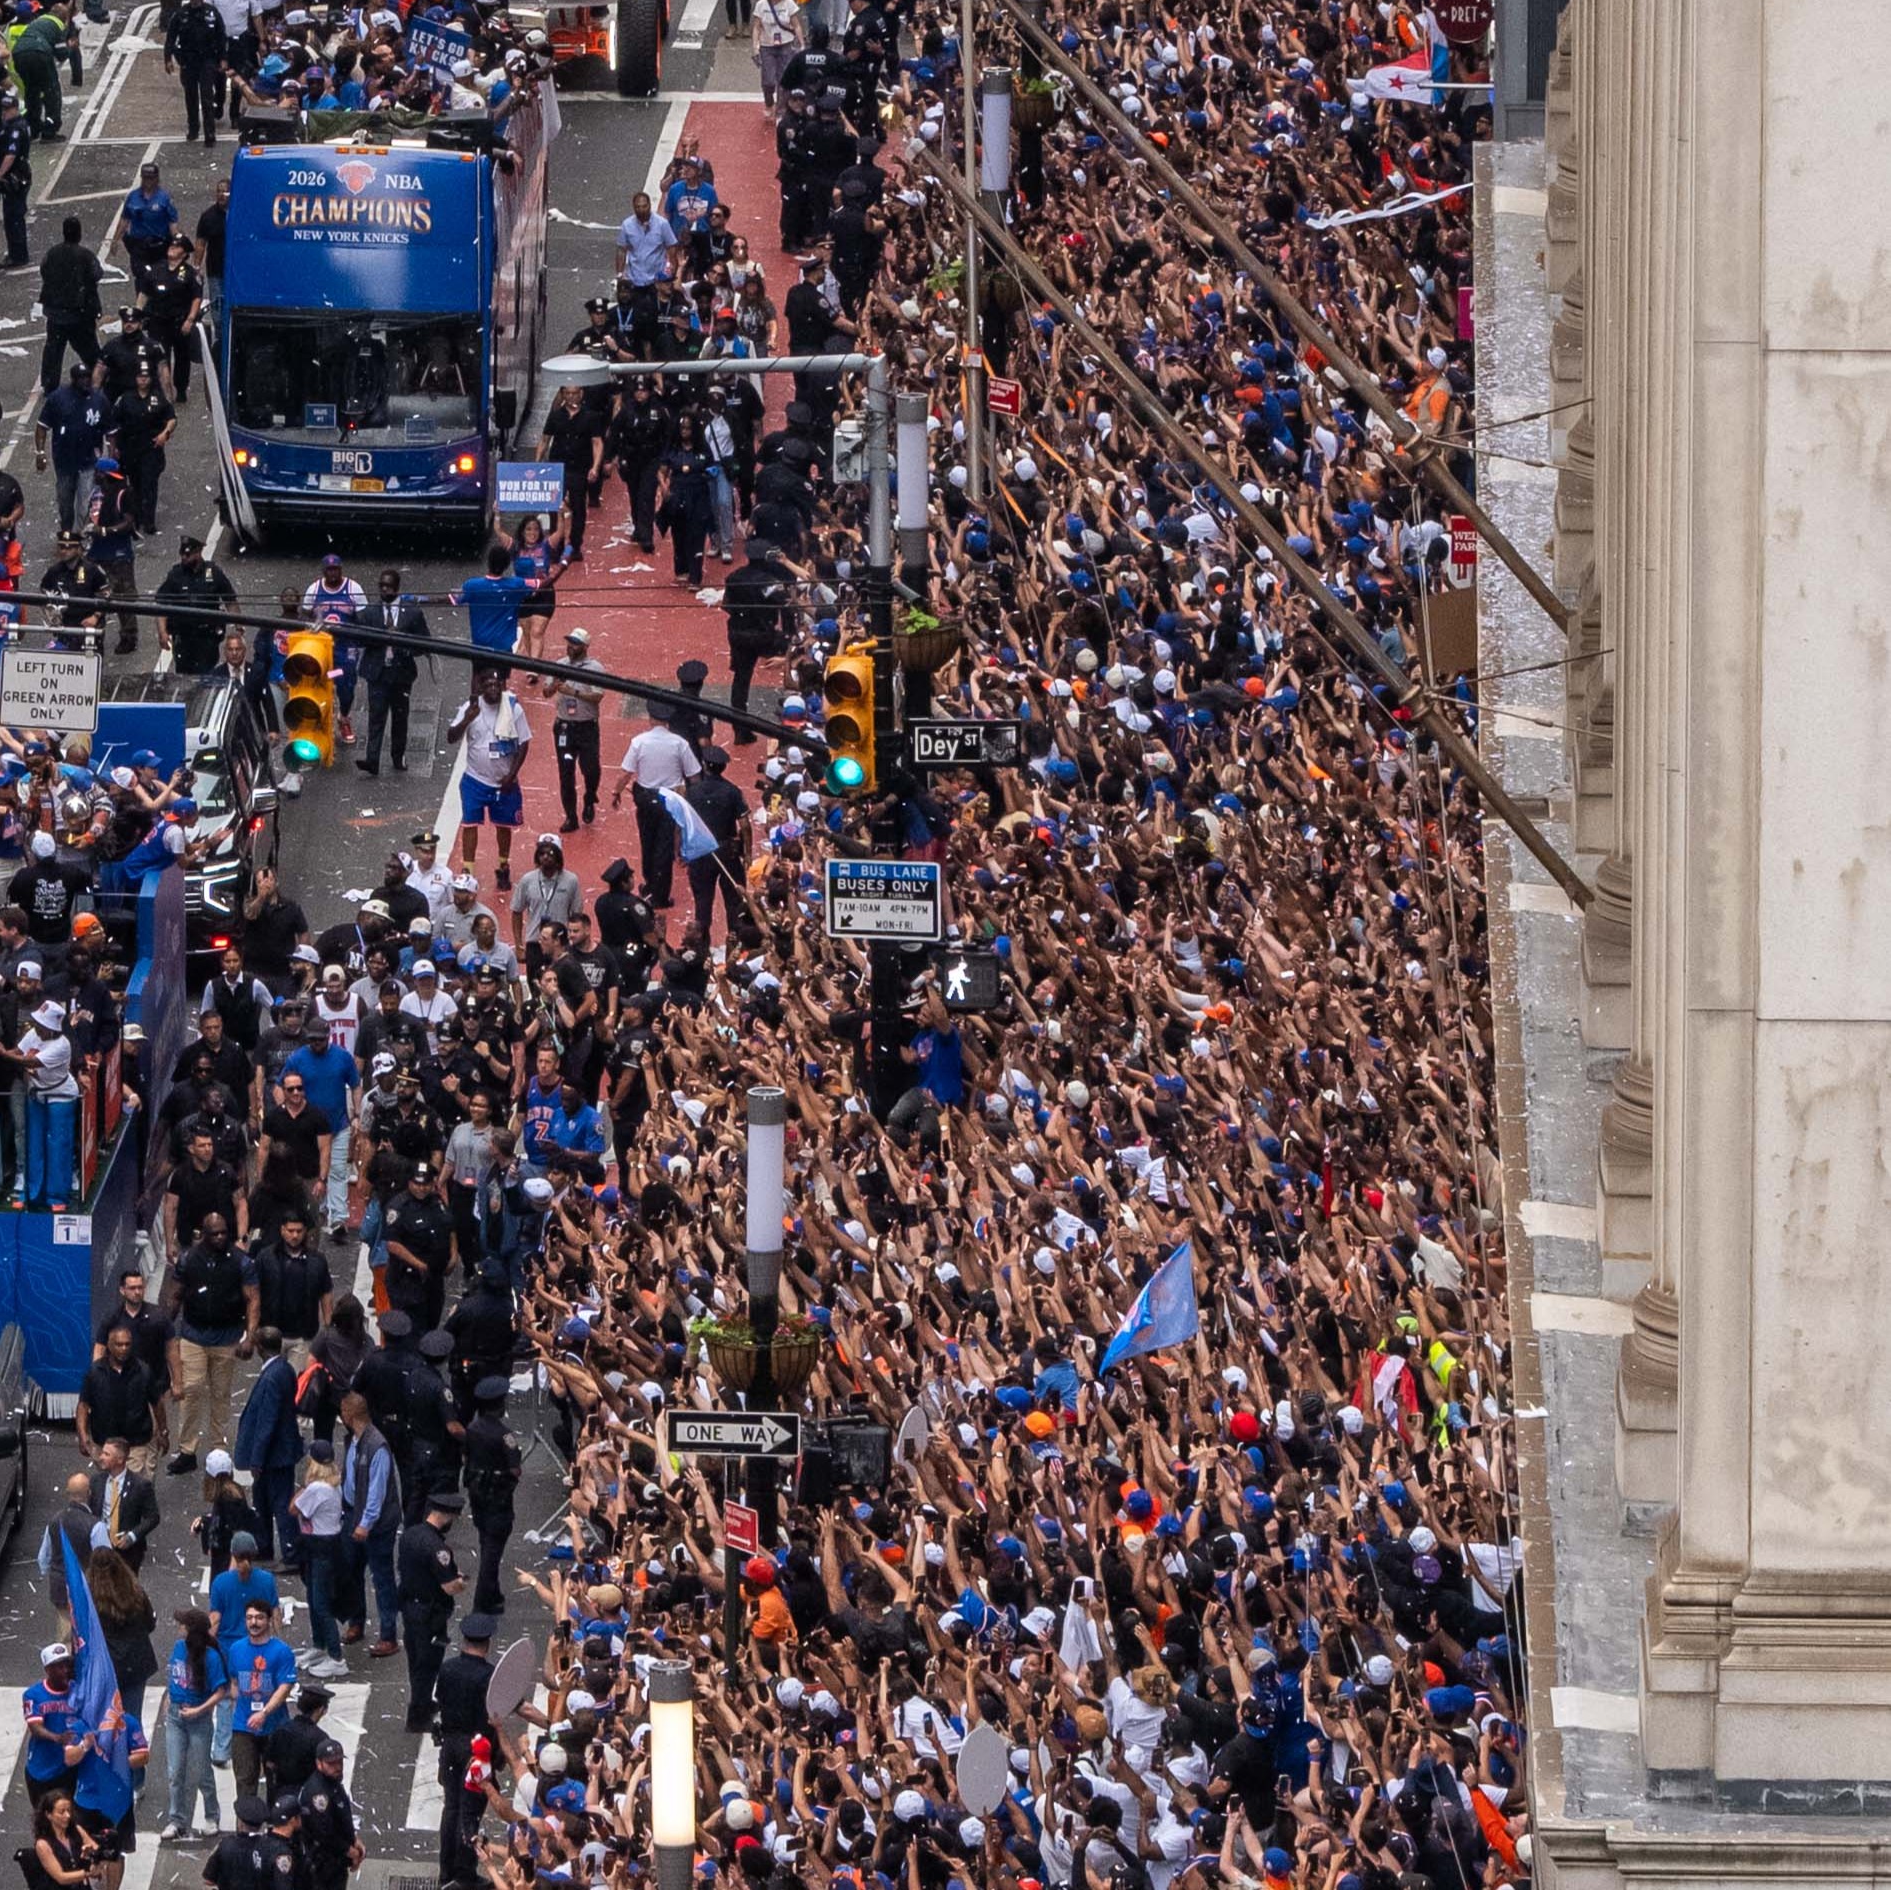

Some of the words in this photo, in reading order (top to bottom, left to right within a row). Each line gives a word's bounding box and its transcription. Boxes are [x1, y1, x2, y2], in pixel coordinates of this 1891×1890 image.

[1451, 5, 1479, 24] PRET
[412, 29, 448, 50] LET'S
[448, 42, 466, 58] GO
[409, 42, 462, 68] KNCKS
[288, 170, 326, 187] 2026
[385, 175, 424, 190] NBA
[272, 194, 432, 229] CHAMPIONS
[293, 229, 323, 242] NEW
[327, 230, 360, 243] YORK
[362, 231, 410, 245] KNICKS
[332, 452, 356, 463] BIG
[332, 463, 356, 474] BUS
[499, 481, 521, 492] WON
[522, 481, 542, 492] FOR
[543, 481, 562, 492] THE
[16, 661, 47, 674] LEFT
[51, 664, 85, 677] TURN
[40, 678, 59, 690] ON
[3, 690, 45, 704] GREEN
[49, 692, 95, 708] ARROW
[30, 707, 66, 721] ONLY
[920, 733, 959, 761] Dey
[964, 735, 978, 747] ST
[860, 866, 886, 878] BUS
[893, 868, 928, 879] LANE
[838, 879, 882, 891] BUSES
[892, 881, 929, 893] ONLY
[838, 902, 880, 913] 7AM-10AM
[890, 904, 929, 915] 4PM-7PM
[875, 921, 914, 930] MON-FRI
[535, 1120, 550, 1141] 7
[63, 1226, 71, 1242] 1
[686, 1426, 723, 1441] ONE
[740, 1427, 779, 1443] WAY
